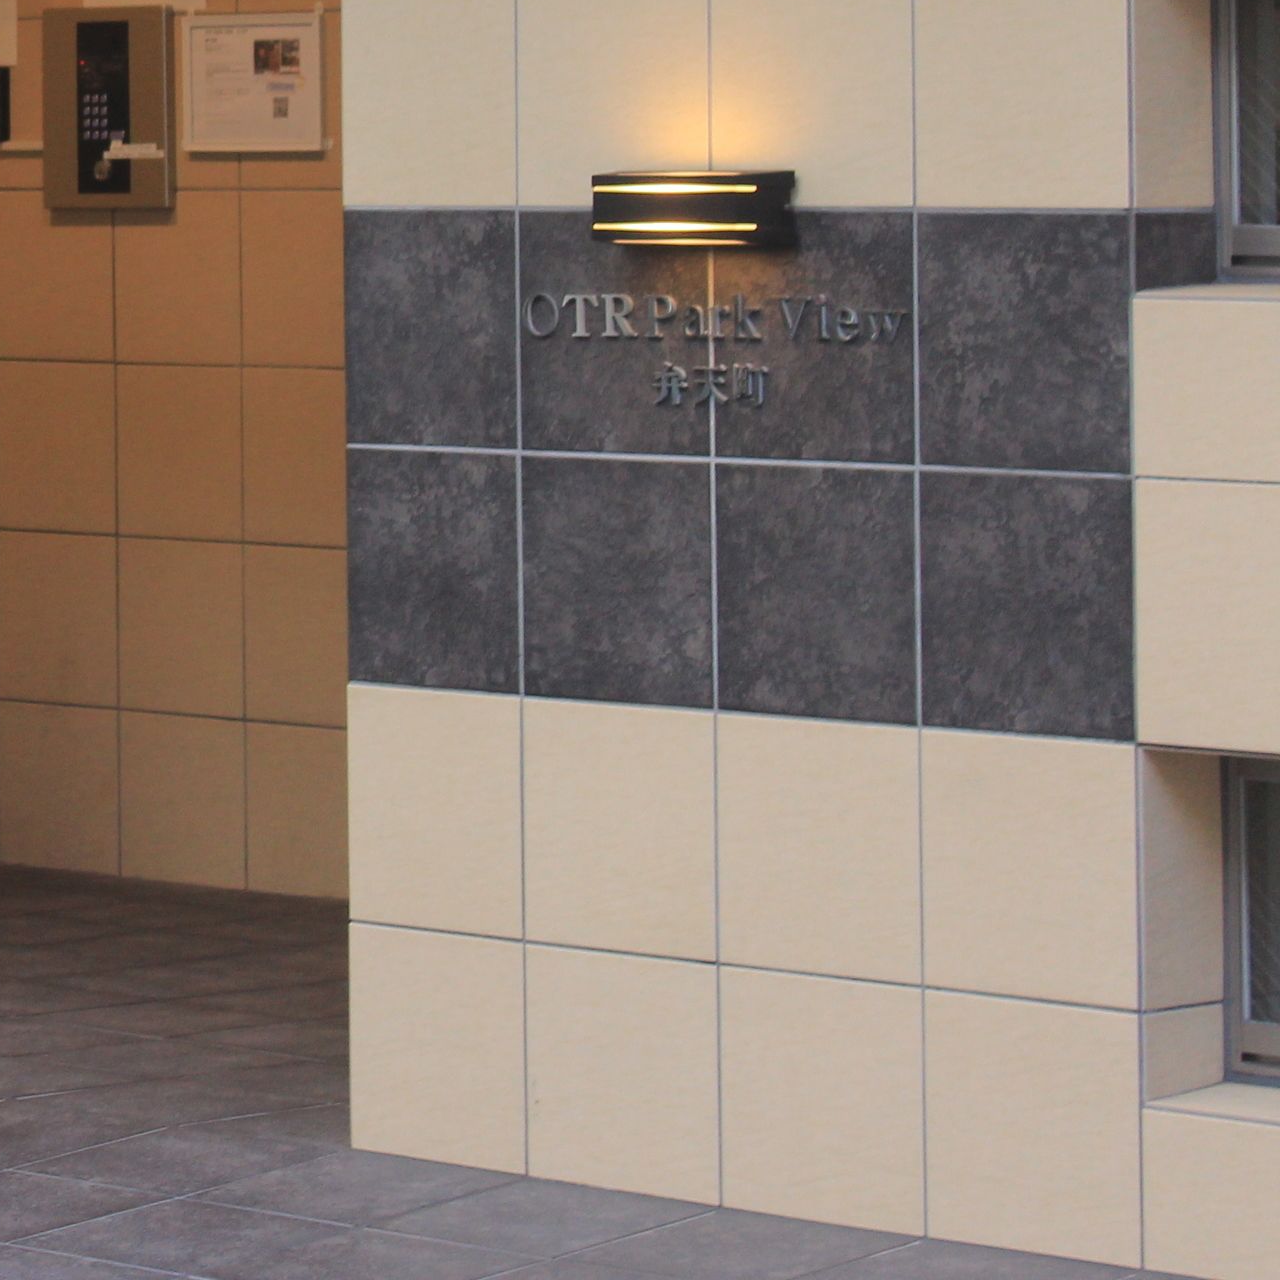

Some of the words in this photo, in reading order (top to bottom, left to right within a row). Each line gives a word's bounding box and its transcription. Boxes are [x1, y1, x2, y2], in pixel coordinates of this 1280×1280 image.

[524, 293, 639, 339] OTR
[644, 293, 763, 341] Park
[769, 293, 910, 342] View
[652, 361, 770, 406] 弁天町
